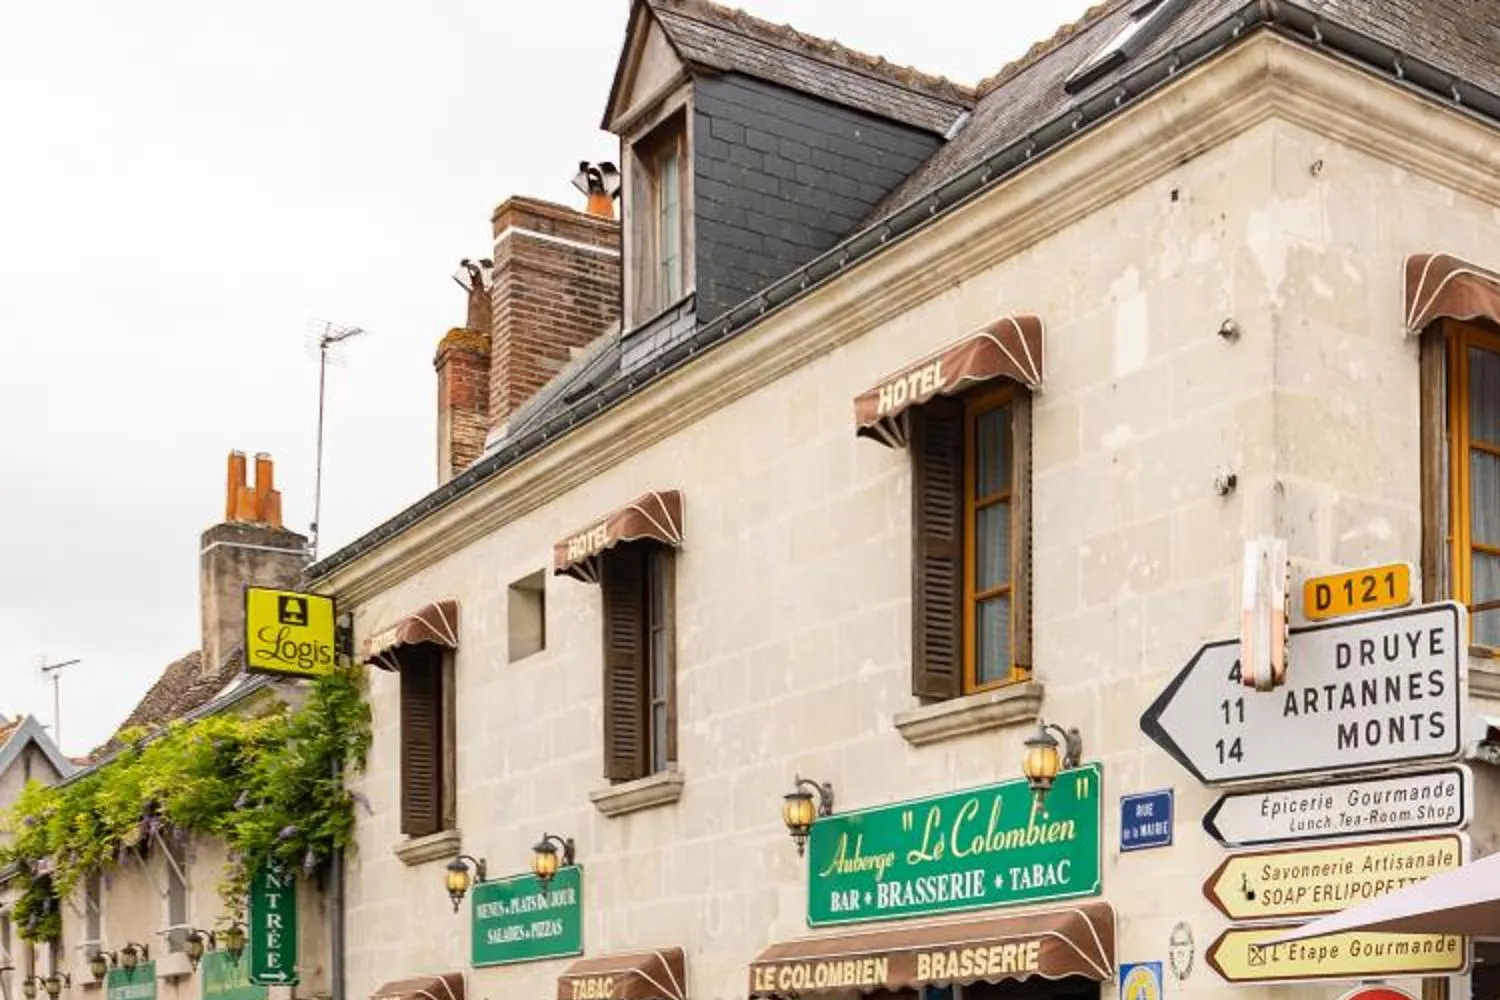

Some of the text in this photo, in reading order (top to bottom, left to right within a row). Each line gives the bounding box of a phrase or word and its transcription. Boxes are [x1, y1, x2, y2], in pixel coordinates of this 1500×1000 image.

[878, 361, 948, 414] HOTEL
[1315, 572, 1396, 611] D 121
[255, 625, 331, 669] Logis
[1336, 627, 1444, 669] DRUYE
[1221, 669, 1445, 725] 11 ARTANNES
[1215, 711, 1446, 765] 14 MONTS
[1136, 802, 1153, 818] RUE
[1261, 781, 1455, 819] Épicerie Gourmande
[1140, 820, 1168, 837] MAIRIE
[819, 832, 895, 882] Auberge
[1261, 850, 1453, 882] Savonnerie Artisanale
[830, 860, 1071, 913] BAR BRASSERIE TABAC
[1261, 876, 1429, 906] SOAP'ERLIPOPET
[1350, 933, 1457, 958] Gourmande
[755, 941, 1040, 992] LE COLOMBIEN BRASSERIE
[571, 977, 615, 1000] TABAC
